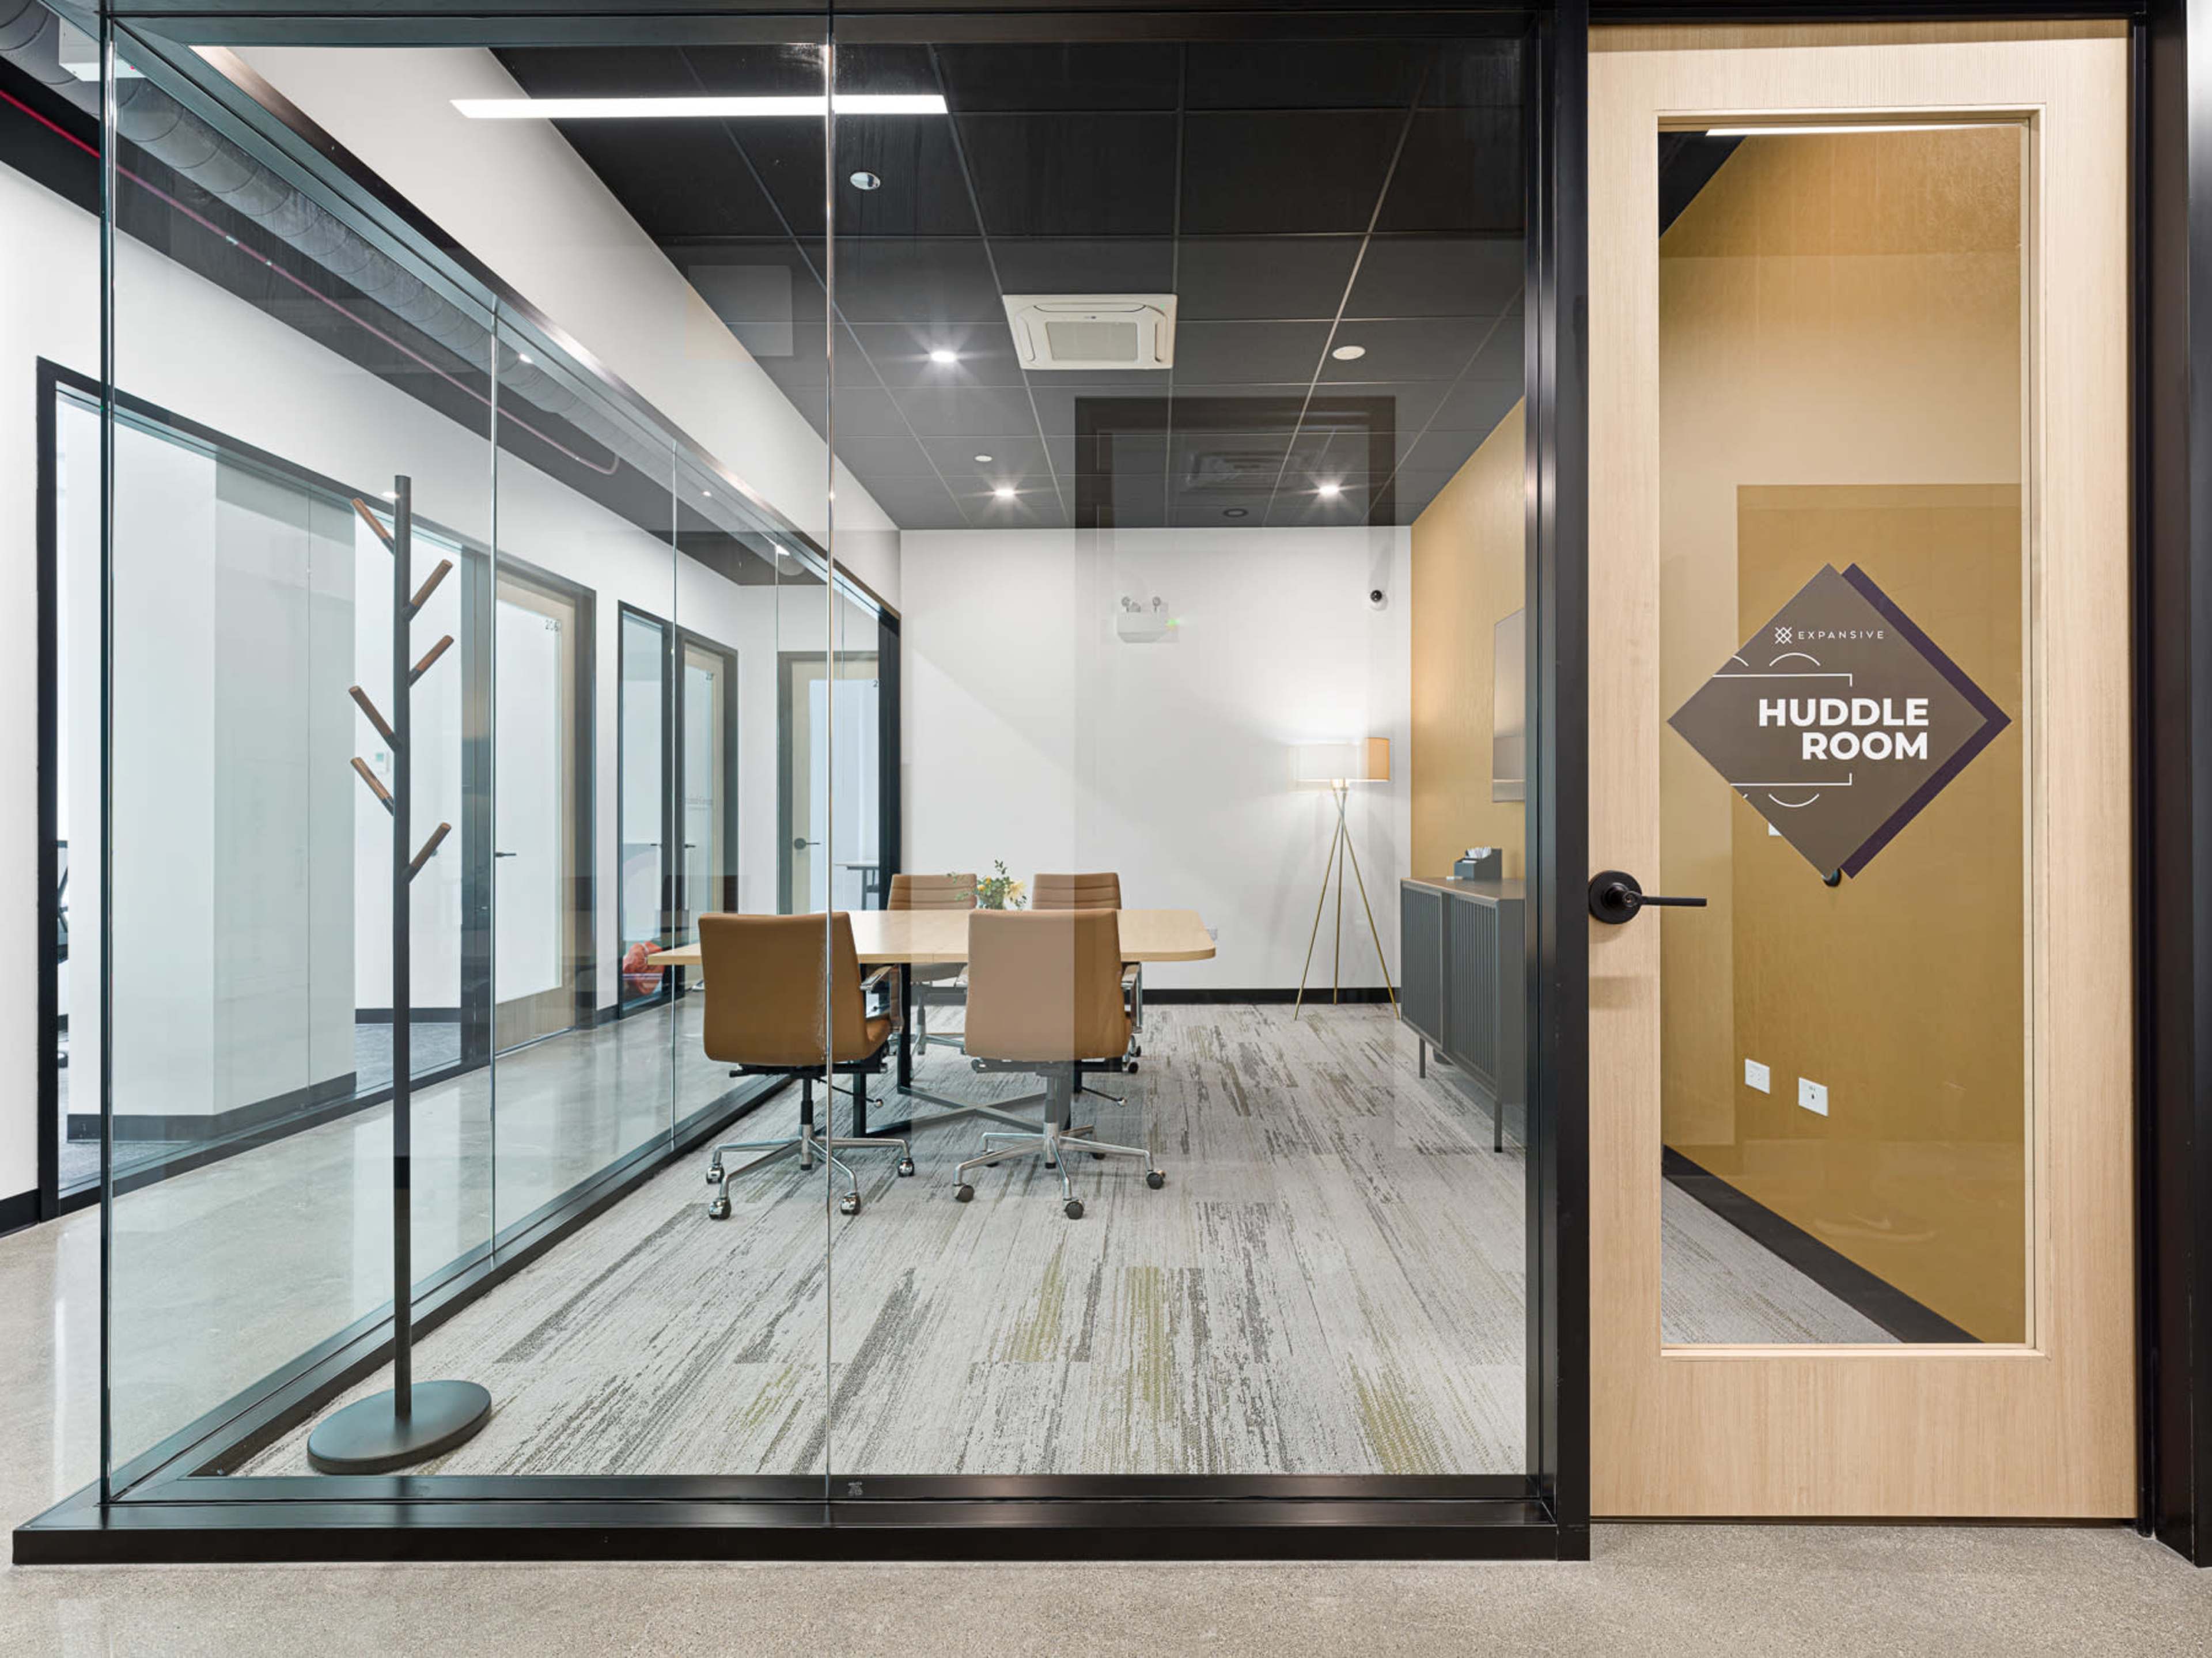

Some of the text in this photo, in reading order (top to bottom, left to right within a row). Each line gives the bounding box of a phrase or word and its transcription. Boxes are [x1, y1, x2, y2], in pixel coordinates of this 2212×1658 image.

[1798, 630, 1884, 640] EXPANSIVE
[1759, 698, 1929, 726] HUDDLE
[1802, 731, 1927, 760] ROOM
